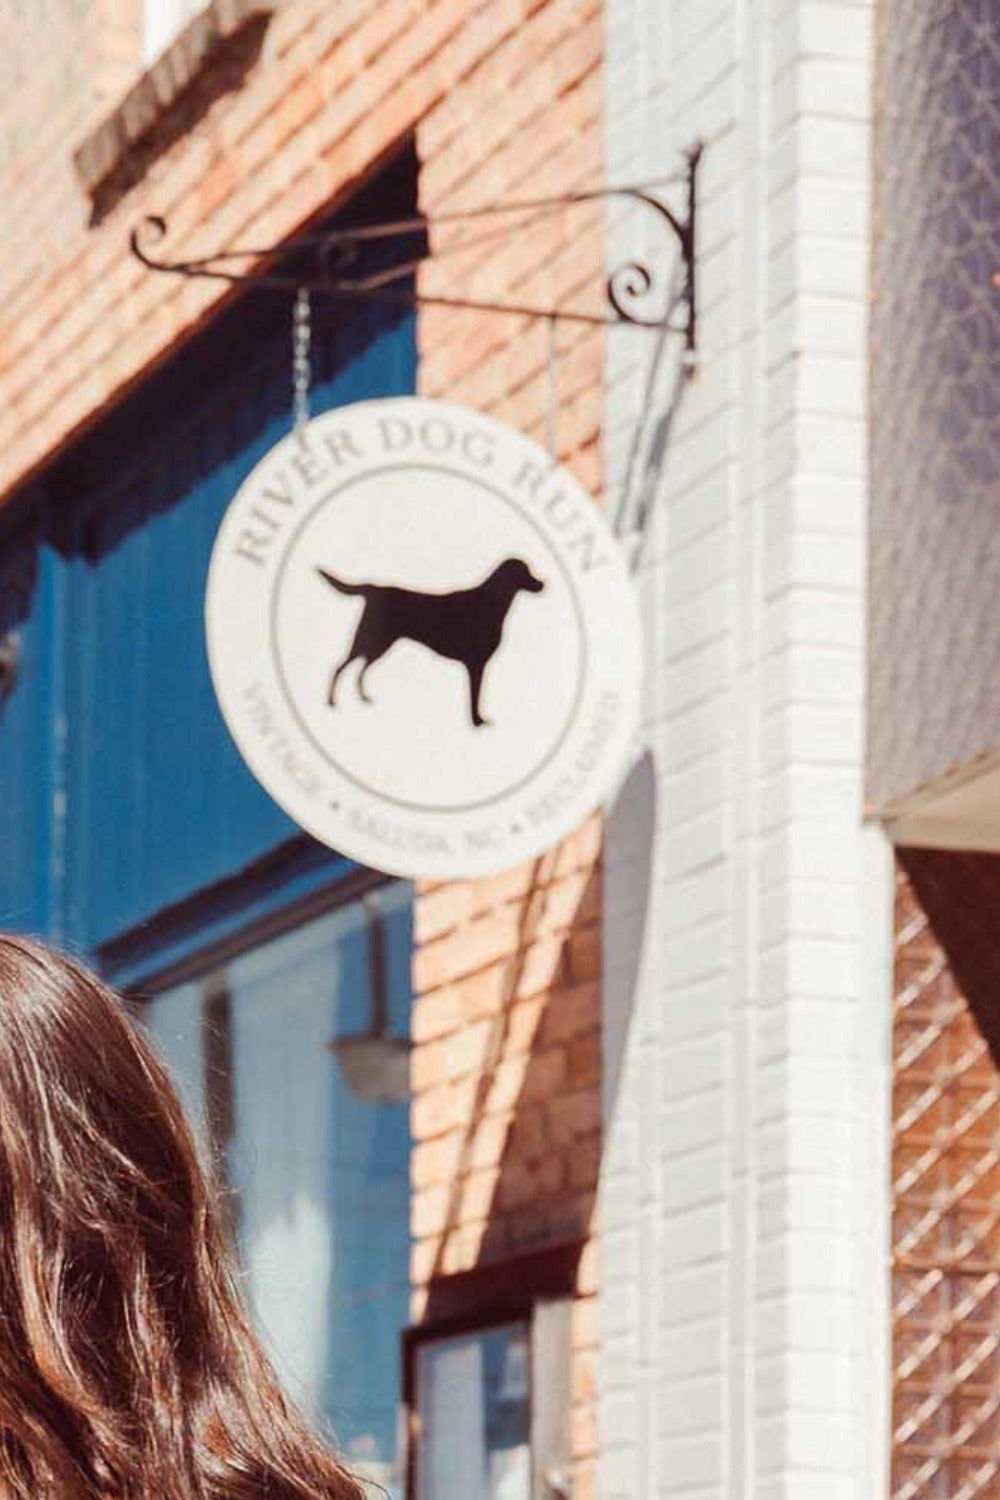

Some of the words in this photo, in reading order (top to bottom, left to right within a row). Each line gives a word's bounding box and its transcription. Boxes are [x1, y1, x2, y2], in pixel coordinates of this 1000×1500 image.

[232, 427, 365, 568] RIVER
[378, 416, 497, 468] DOG
[512, 460, 611, 573] RUN
